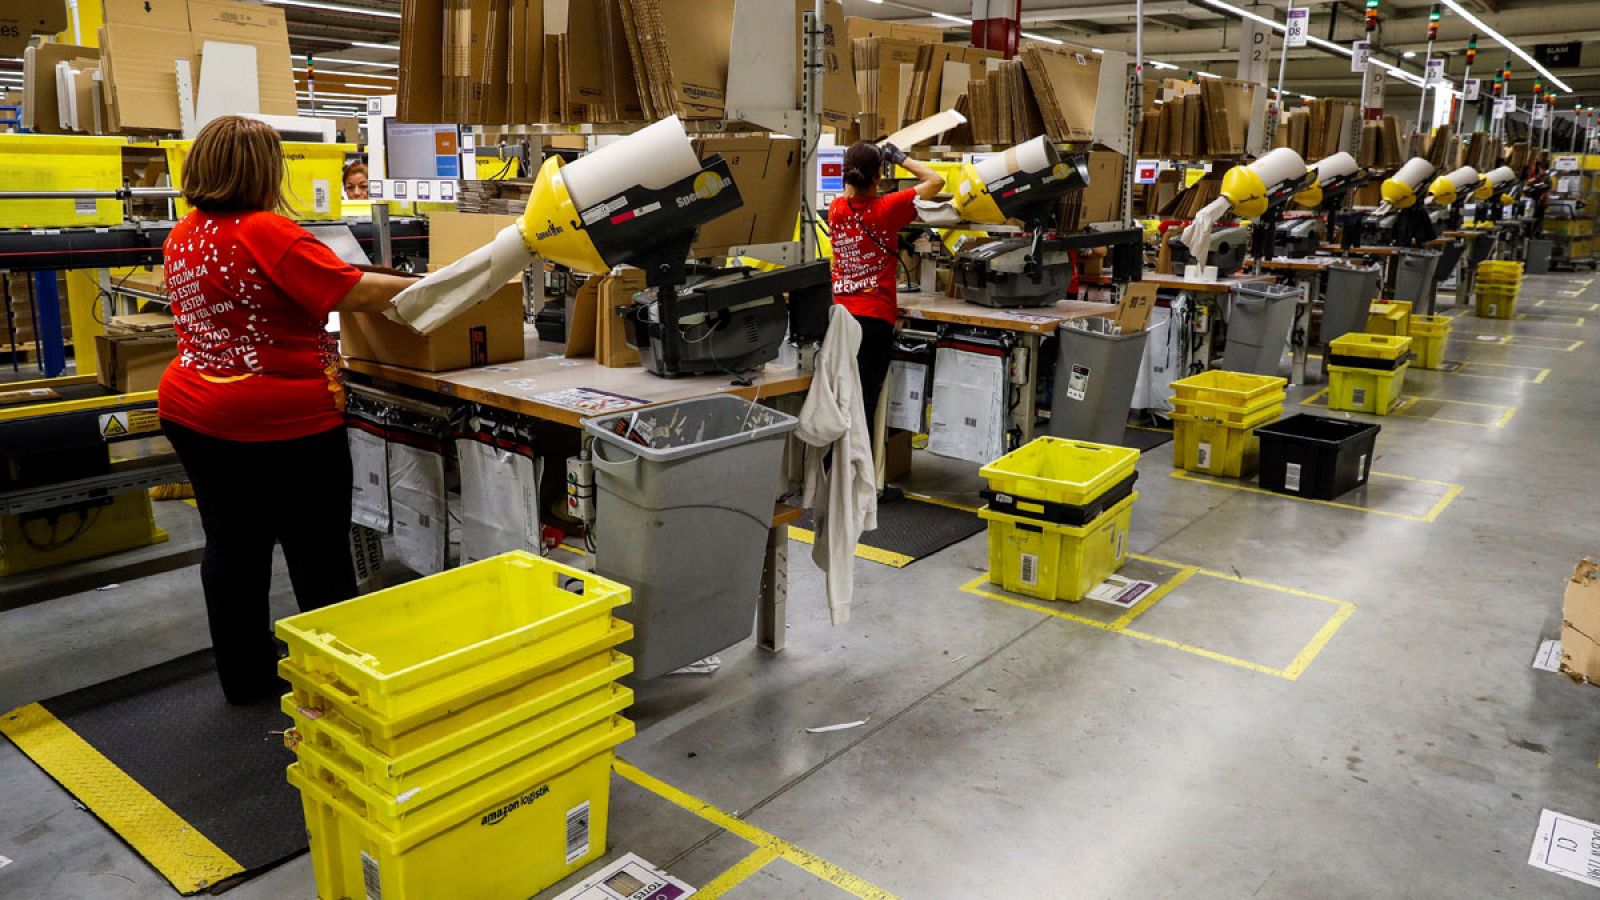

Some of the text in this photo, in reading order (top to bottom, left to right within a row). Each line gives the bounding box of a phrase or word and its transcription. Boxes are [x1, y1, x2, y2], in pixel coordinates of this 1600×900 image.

[1254, 32, 1265, 45] D
[1253, 51, 1262, 62] 2
[1374, 74, 1382, 82] D
[173, 258, 186, 272] AM
[195, 264, 208, 277] ZA
[177, 280, 200, 299] ESTOY
[211, 300, 234, 314] VON
[481, 784, 550, 826] amazon logistik
[633, 882, 662, 900] TOTES
